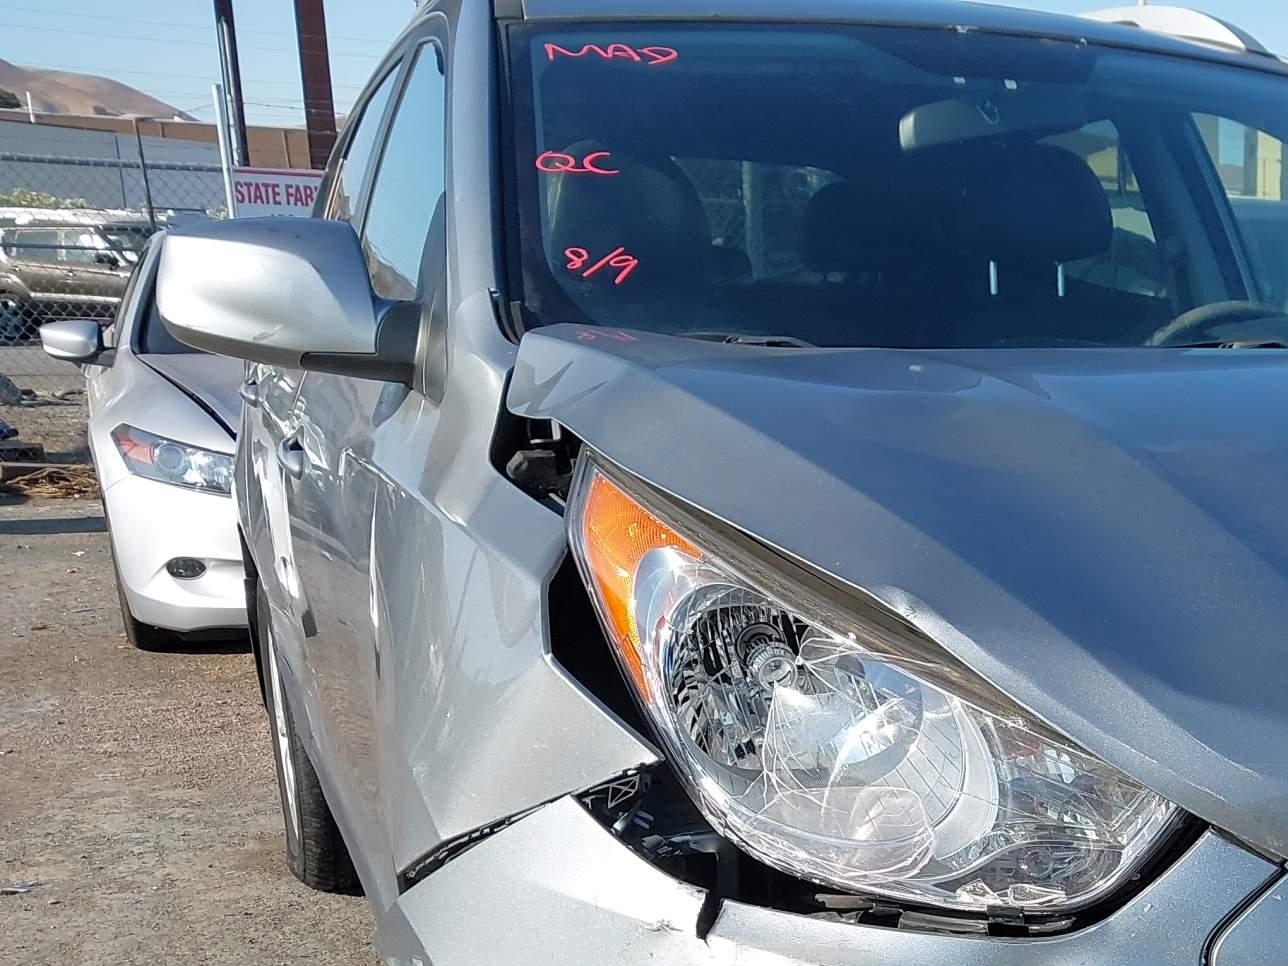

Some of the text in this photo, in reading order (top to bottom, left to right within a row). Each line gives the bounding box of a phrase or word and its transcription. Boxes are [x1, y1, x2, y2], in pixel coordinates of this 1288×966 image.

[535, 151, 620, 174] QC
[235, 181, 319, 207] STATE FAR
[564, 247, 638, 284] 8/9
